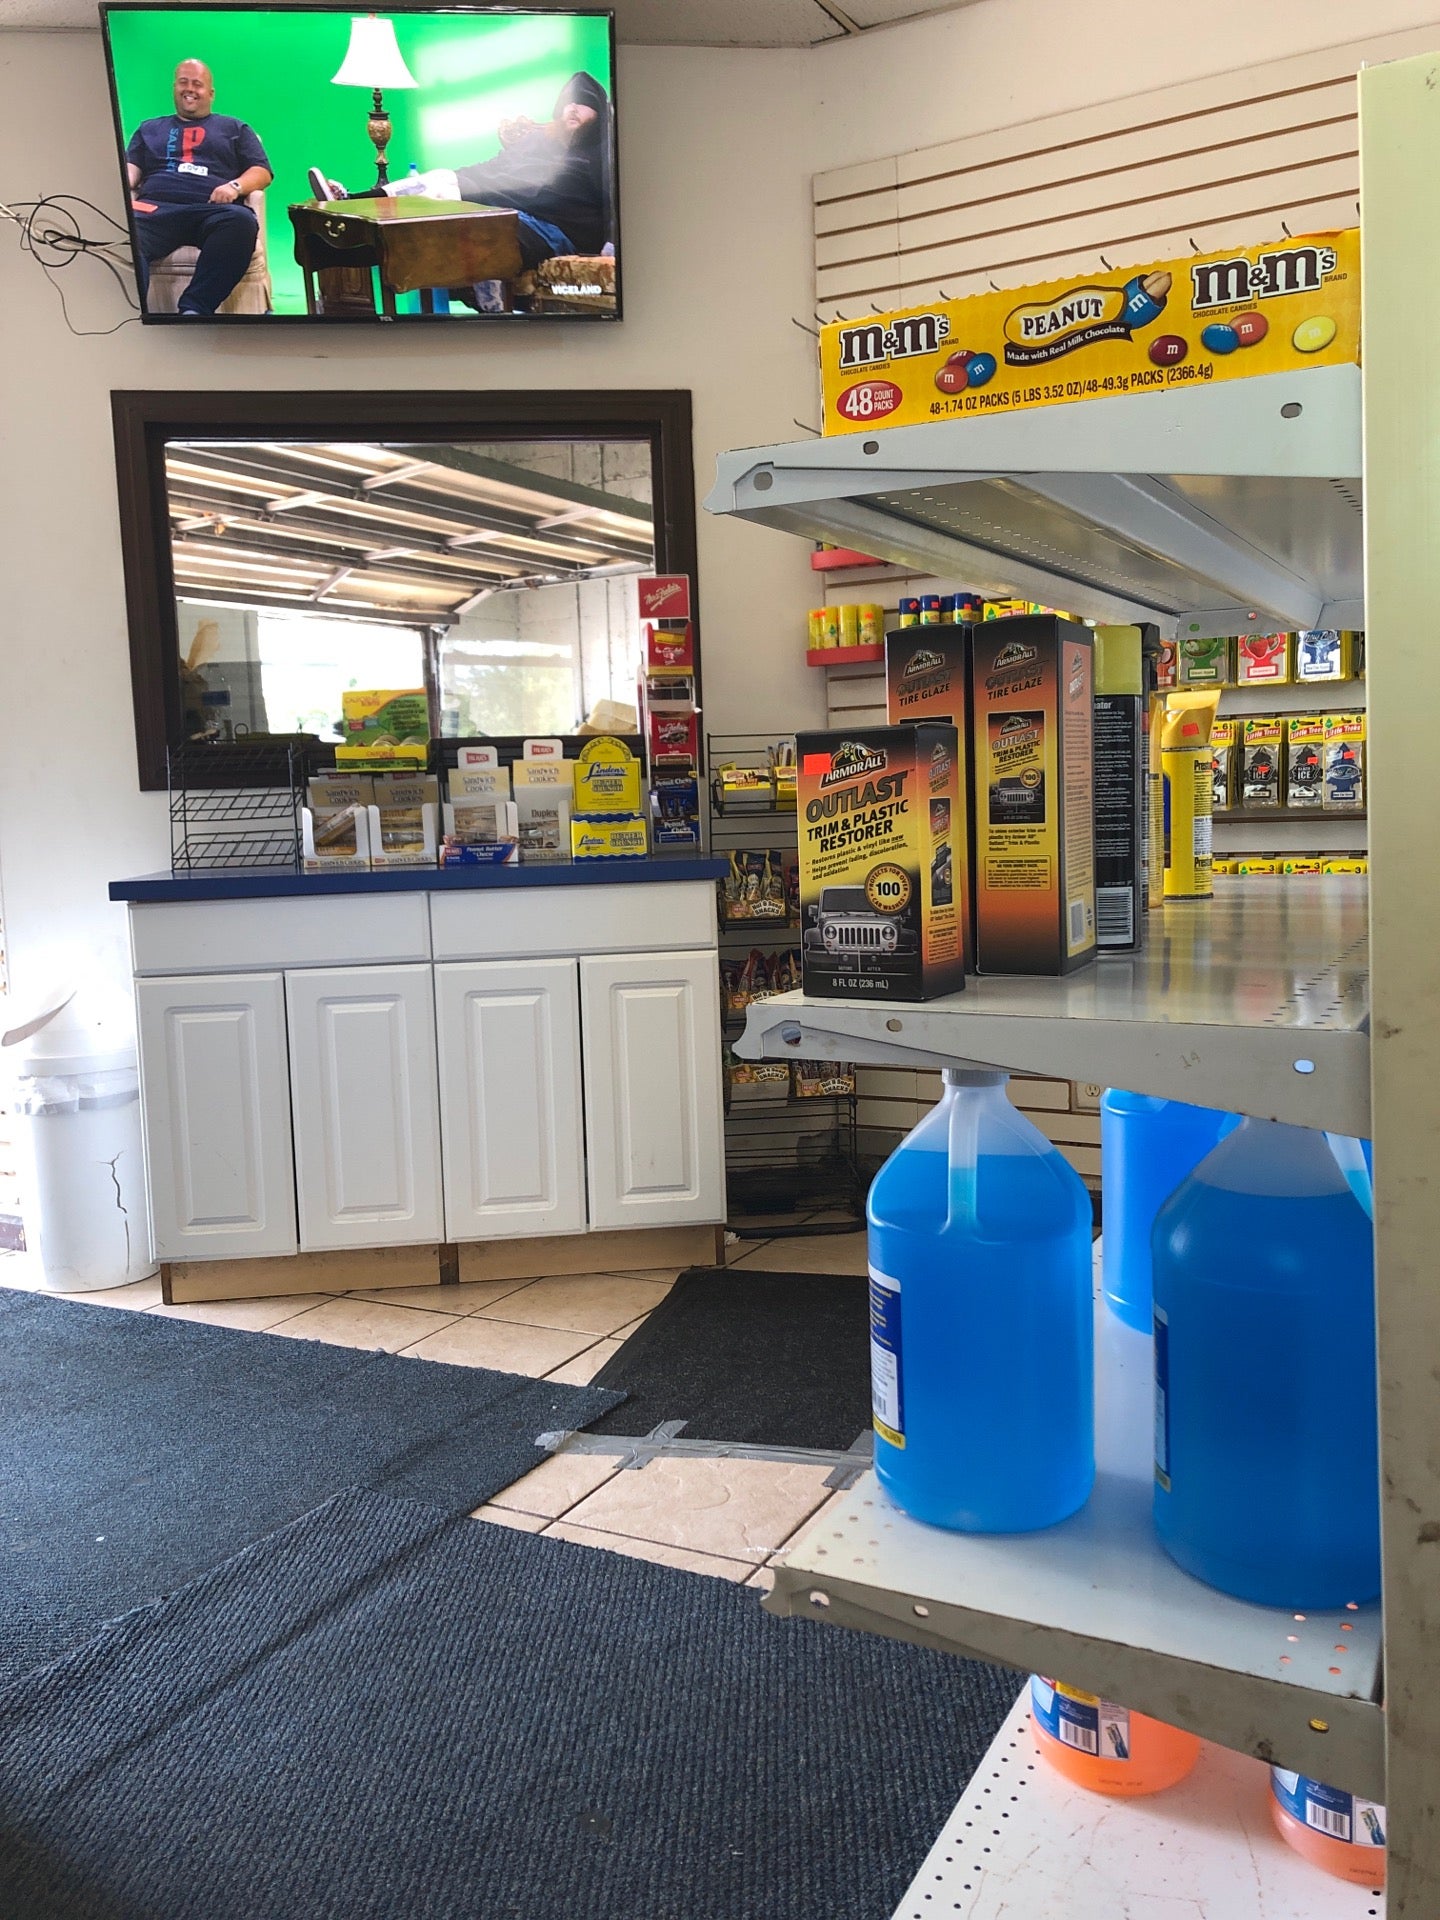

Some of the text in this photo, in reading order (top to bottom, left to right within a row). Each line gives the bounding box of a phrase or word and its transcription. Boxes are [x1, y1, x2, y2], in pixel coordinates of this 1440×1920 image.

[182, 126, 206, 163] P
[1324, 273, 1348, 283] BRAND
[551, 284, 602, 296] VICELAND
[1022, 298, 1103, 336] PEANUT
[1192, 302, 1258, 319] CHOCOLATE CANDIES
[1006, 325, 1126, 361] Made with Real Milk Chocolate
[840, 365, 869, 377] CHOCOLATE
[873, 388, 894, 401] COUNT
[929, 399, 963, 415] 48-1.74
[964, 396, 978, 410] OZ
[979, 391, 1010, 409] PACKS
[1011, 389, 1022, 406] (5
[1023, 387, 1042, 403] LBS
[1043, 383, 1064, 400] 3.52
[1130, 369, 1164, 388] PACKS
[1165, 362, 1214, 384] (2366.4g)
[845, 387, 874, 417] 48
[873, 399, 894, 412] PACKS
[899, 682, 951, 707] TIRE GLAZE
[988, 676, 1043, 701] TIRE GLAZE
[1356, 715, 1362, 723] 6
[1264, 728, 1280, 736] Trees
[1343, 724, 1361, 733] Trees
[992, 729, 1040, 751] OUTLAST
[992, 748, 1009, 759] TRIM
[1014, 739, 1041, 752] PLASTIC
[998, 748, 1034, 764] RESTORER
[1253, 769, 1266, 780] ICE
[1297, 770, 1312, 780] ICE
[806, 769, 909, 824] OUTLAST
[531, 809, 559, 818] Duplex
[807, 820, 840, 842] TRIM
[841, 818, 851, 831] &
[853, 799, 909, 828] PLASTIC
[820, 819, 894, 853] RESTORER
[811, 854, 836, 866] Restores
[836, 848, 856, 860] plastic
[862, 840, 878, 851] vinyl
[878, 838, 891, 846] like
[890, 833, 905, 843] new
[811, 863, 827, 874] Helps
[827, 858, 848, 870] prevent
[812, 865, 850, 881] and oxidation
[1268, 864, 1275, 872] 3
[1354, 866, 1362, 874] 3
[868, 867, 909, 892] PROTECTS FOR OVER
[875, 881, 901, 897] 100
[871, 897, 906, 911] CAR WASHES
[832, 978, 838, 987] 8
[838, 978, 847, 988] FL
[847, 978, 858, 988] OZ
[858, 978, 874, 990] (236
